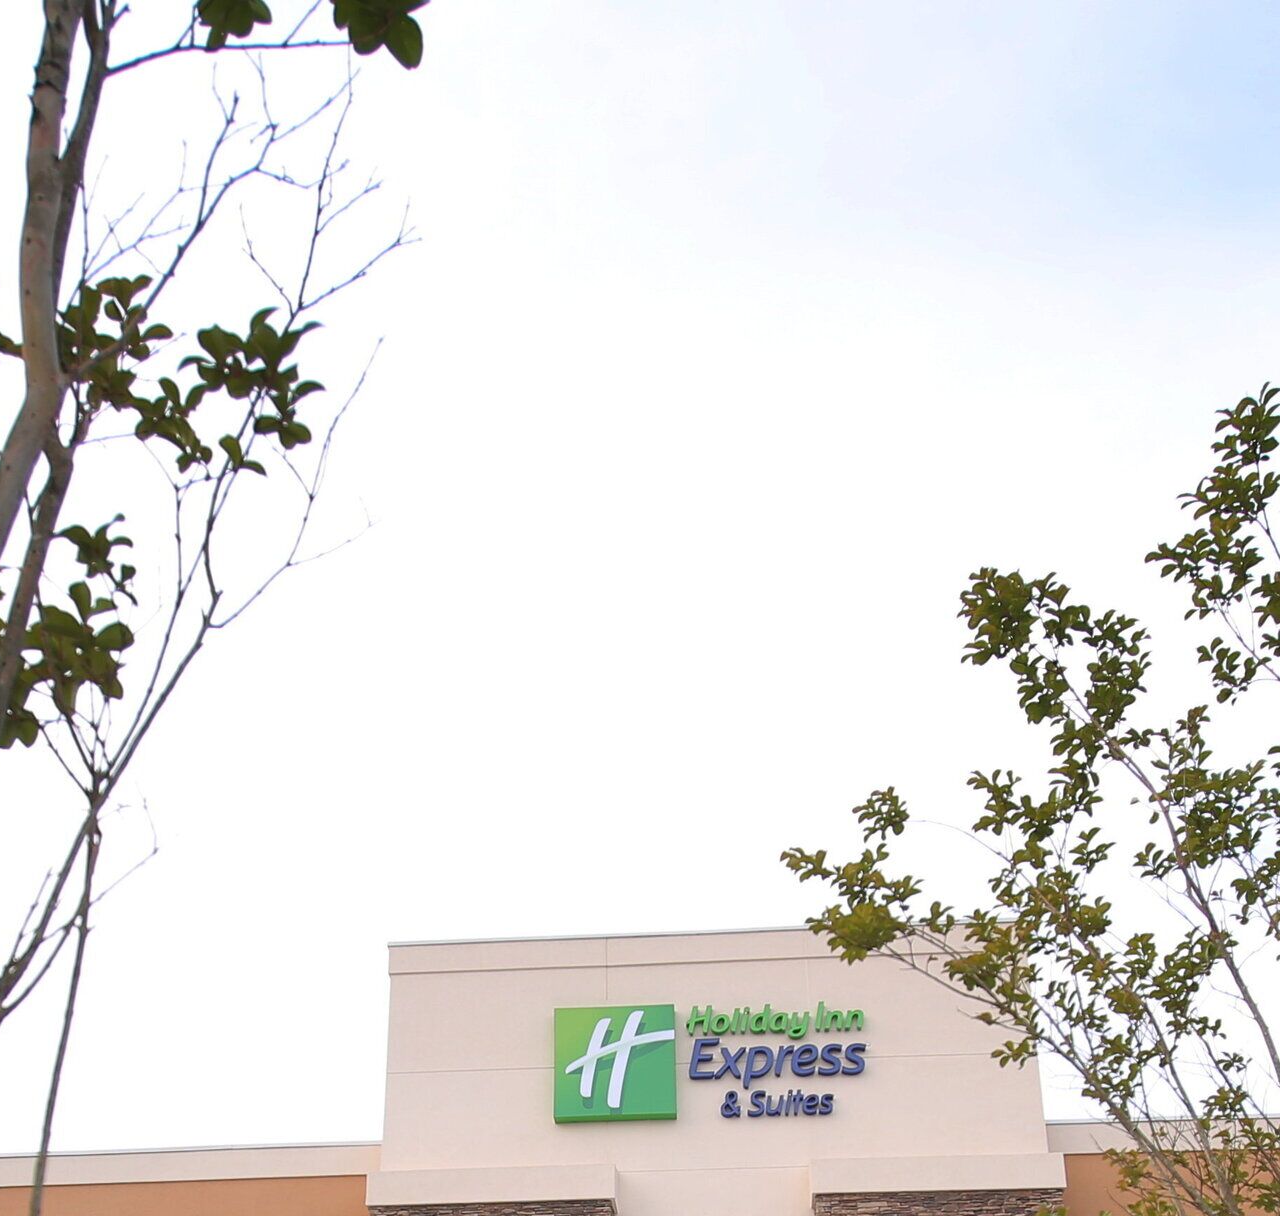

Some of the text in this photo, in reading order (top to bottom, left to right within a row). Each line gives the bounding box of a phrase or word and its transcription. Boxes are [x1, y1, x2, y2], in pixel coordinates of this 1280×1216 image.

[686, 1001, 864, 1039] Holiday Inn
[689, 1038, 866, 1089] Express
[721, 1089, 834, 1118] & Suites
